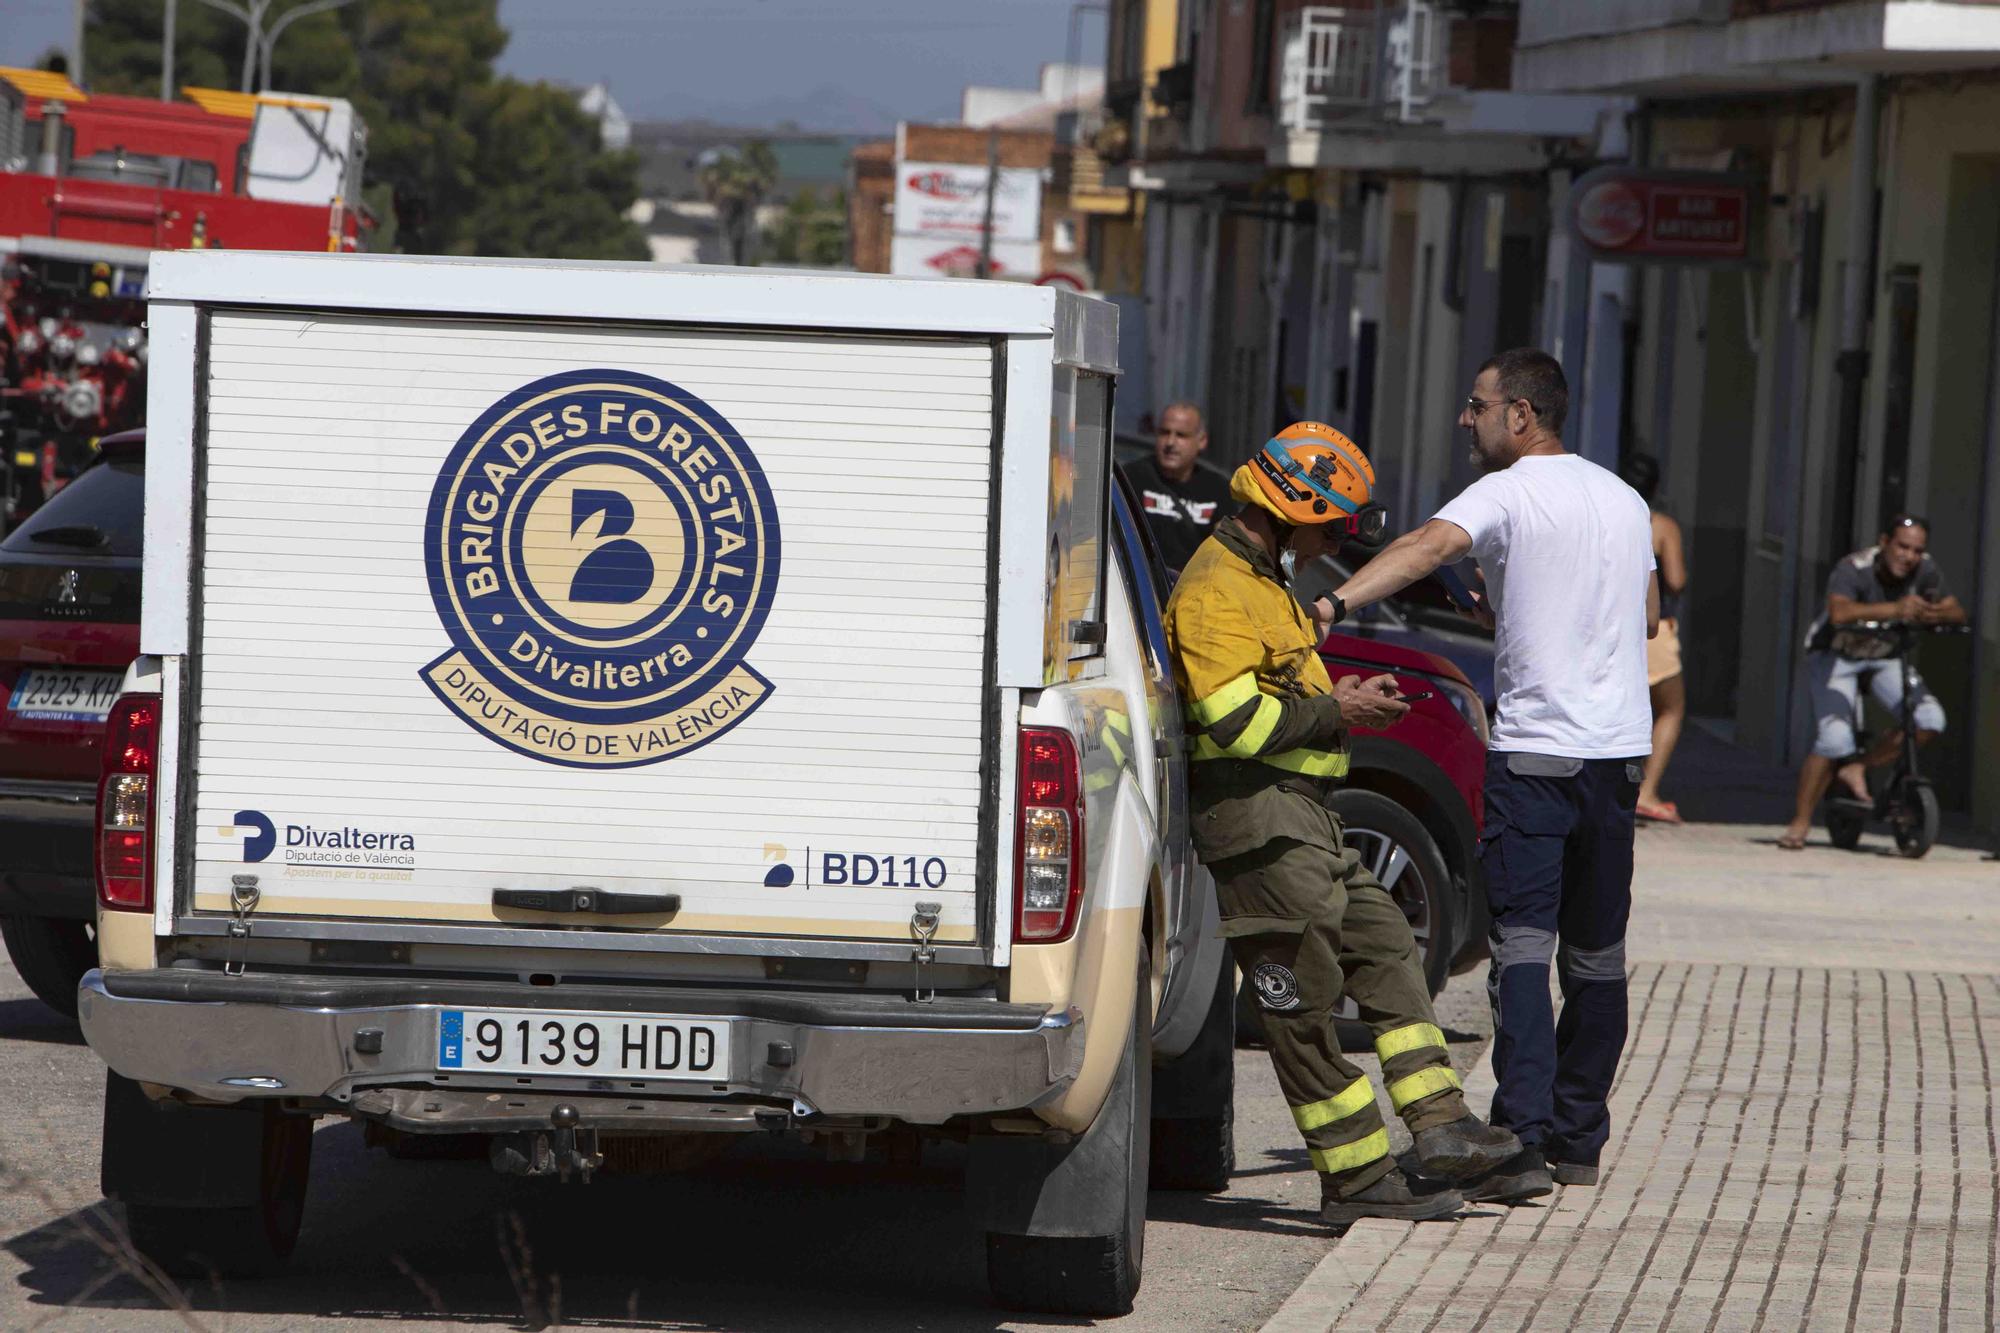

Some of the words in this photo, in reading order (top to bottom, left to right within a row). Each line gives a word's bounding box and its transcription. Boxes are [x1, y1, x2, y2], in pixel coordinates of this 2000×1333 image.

[460, 405, 589, 599] BRIGADES
[600, 402, 747, 619] FORESTALS
[508, 630, 693, 690] Divalterra
[25, 675, 84, 706] 2325
[445, 668, 576, 752] DIPUTACIÓ
[586, 735, 619, 755] DE
[626, 685, 751, 753] VALÈNCIA
[287, 825, 415, 851] Divalterra
[285, 849, 342, 863] Diputació
[345, 852, 361, 863] de
[823, 853, 947, 889] BD110
[334, 870, 353, 880] per
[446, 1046, 457, 1059] E
[476, 1018, 600, 1067] 9139
[621, 1024, 716, 1072] HDD
